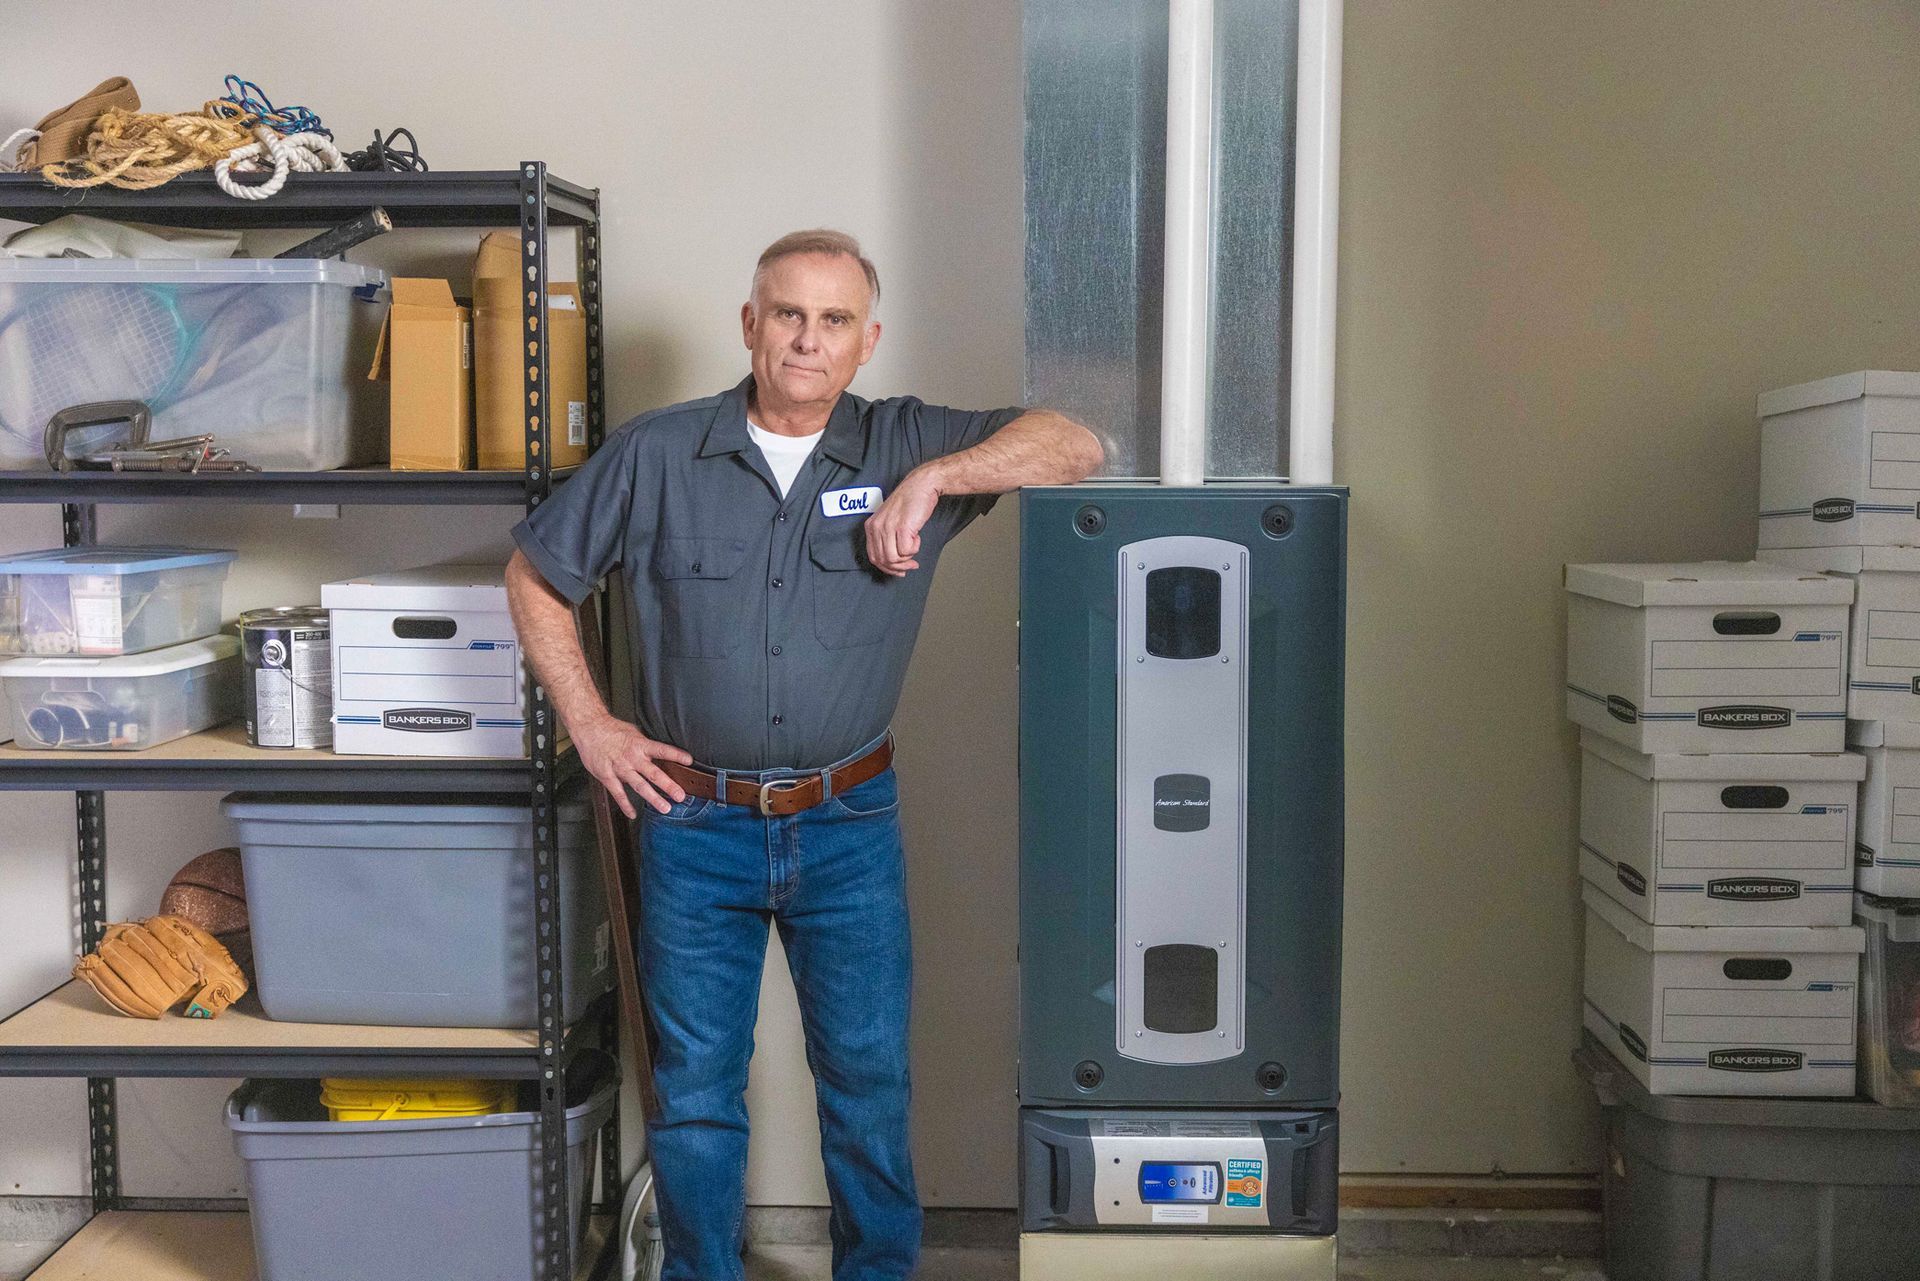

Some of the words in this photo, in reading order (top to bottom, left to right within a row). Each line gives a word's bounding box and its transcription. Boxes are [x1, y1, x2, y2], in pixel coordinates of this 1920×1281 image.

[839, 491, 869, 511] Carl
[1839, 505, 1852, 513] BOX
[388, 715, 442, 725] BANKERS
[443, 716, 467, 725] BOX
[1703, 713, 1760, 722] BANKERS
[1761, 713, 1786, 721] BOX
[1155, 798, 1181, 806] American
[1713, 885, 1769, 893] BANKERS
[1770, 885, 1796, 893] BOX
[1714, 1056, 1770, 1065] BANKERS
[1771, 1056, 1798, 1065] BOX
[1229, 1161, 1261, 1169] CERTIFIED
